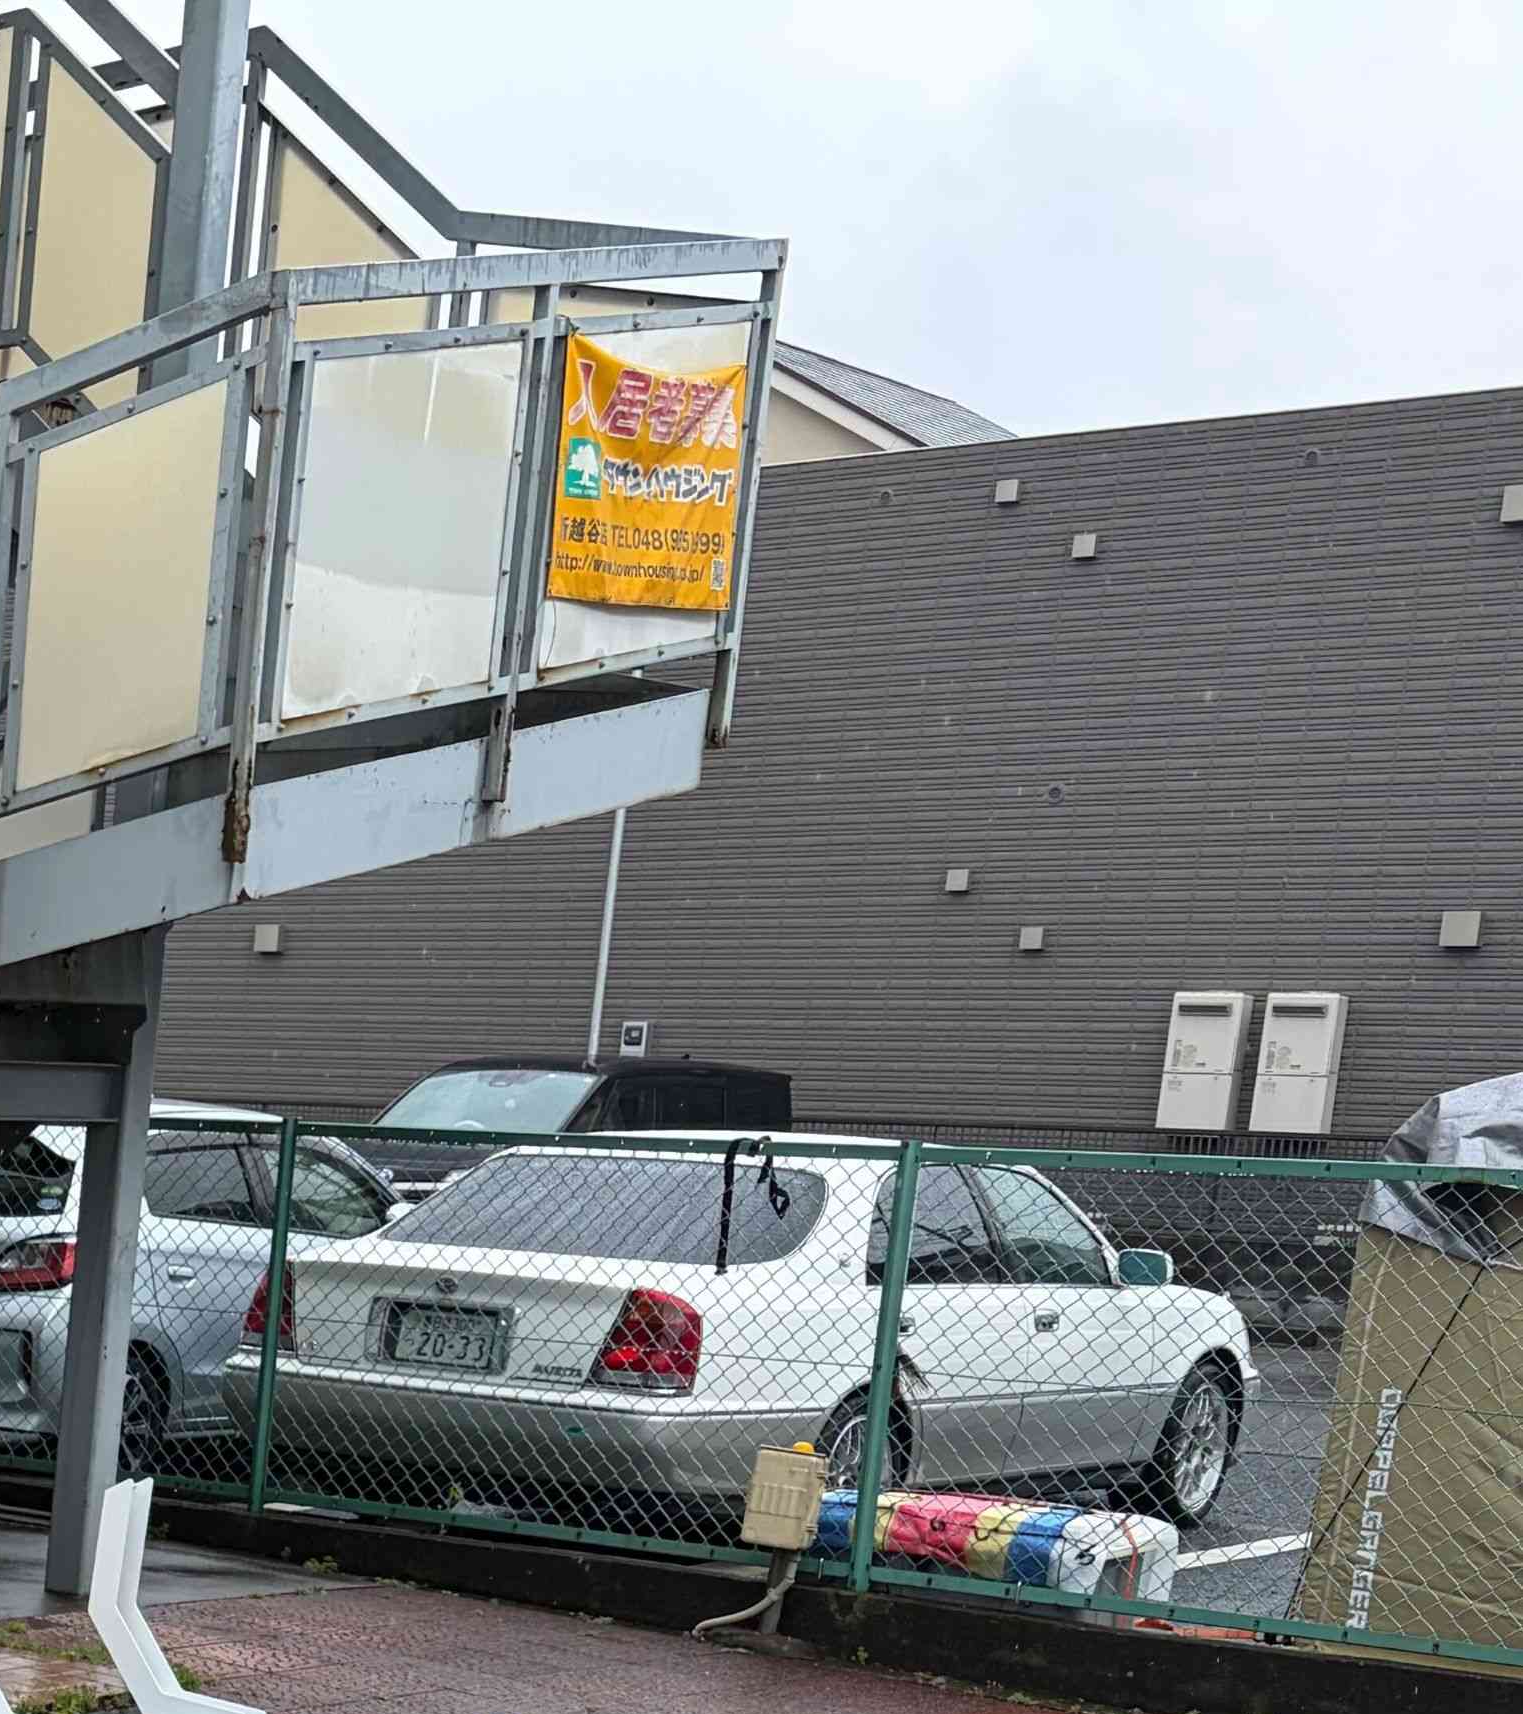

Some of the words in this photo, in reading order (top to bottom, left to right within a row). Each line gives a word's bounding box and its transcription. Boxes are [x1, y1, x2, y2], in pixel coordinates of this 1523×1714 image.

[568, 358, 737, 449] 入居者募集
